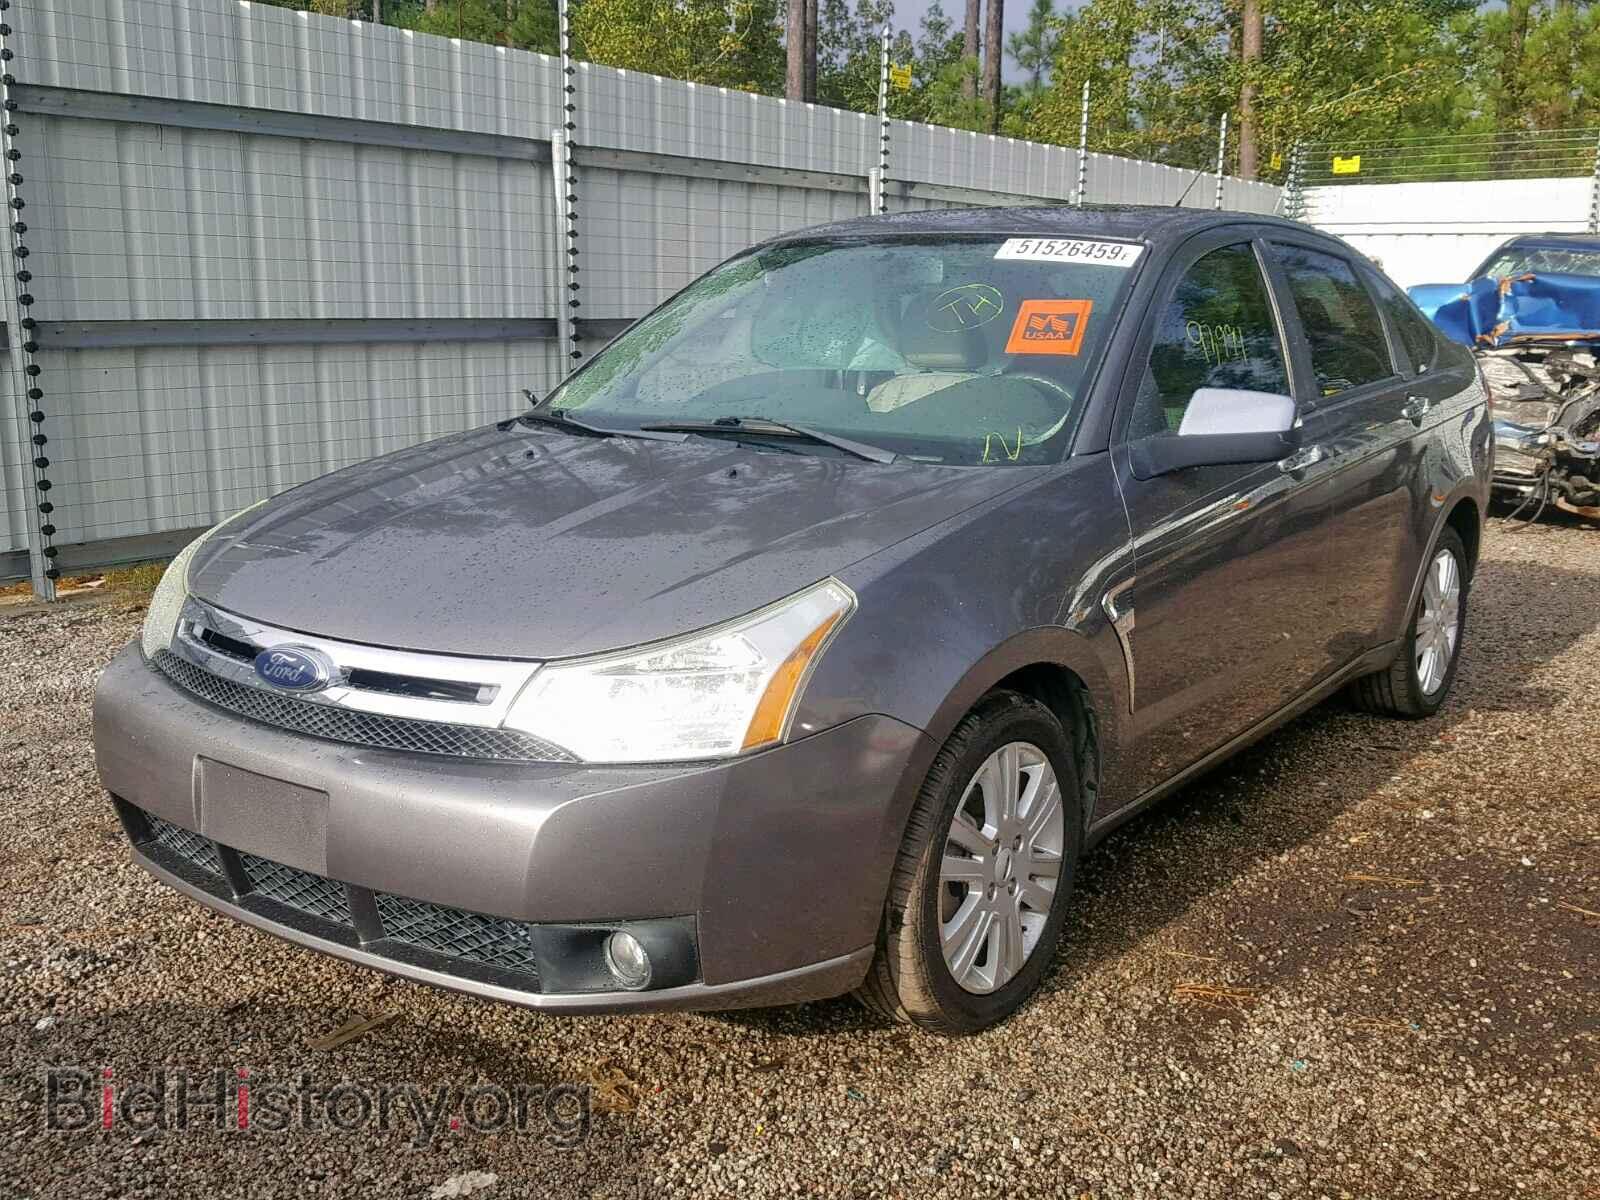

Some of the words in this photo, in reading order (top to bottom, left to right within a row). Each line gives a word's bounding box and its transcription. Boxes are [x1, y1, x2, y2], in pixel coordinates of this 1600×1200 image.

[1016, 239, 1123, 260] 51526459
[1025, 331, 1064, 339] USAA
[263, 652, 304, 682] Ford
